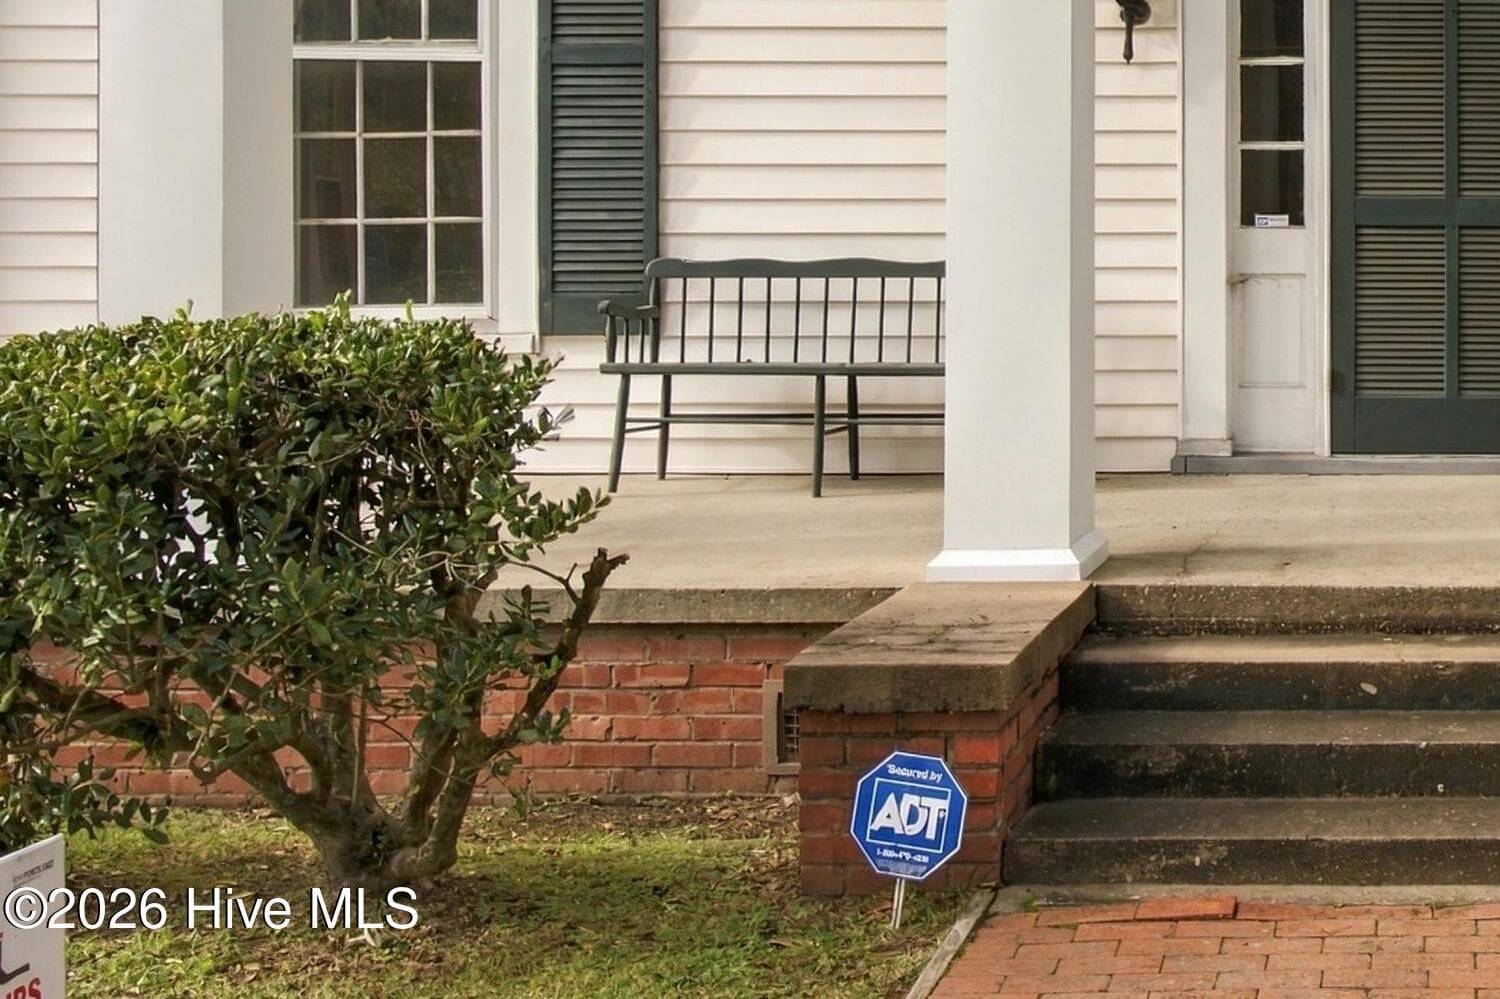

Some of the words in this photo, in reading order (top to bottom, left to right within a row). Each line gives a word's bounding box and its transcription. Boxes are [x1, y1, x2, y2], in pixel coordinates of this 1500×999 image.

[887, 764, 929, 780] Secured
[929, 771, 943, 784] by
[870, 792, 949, 841] ADT
